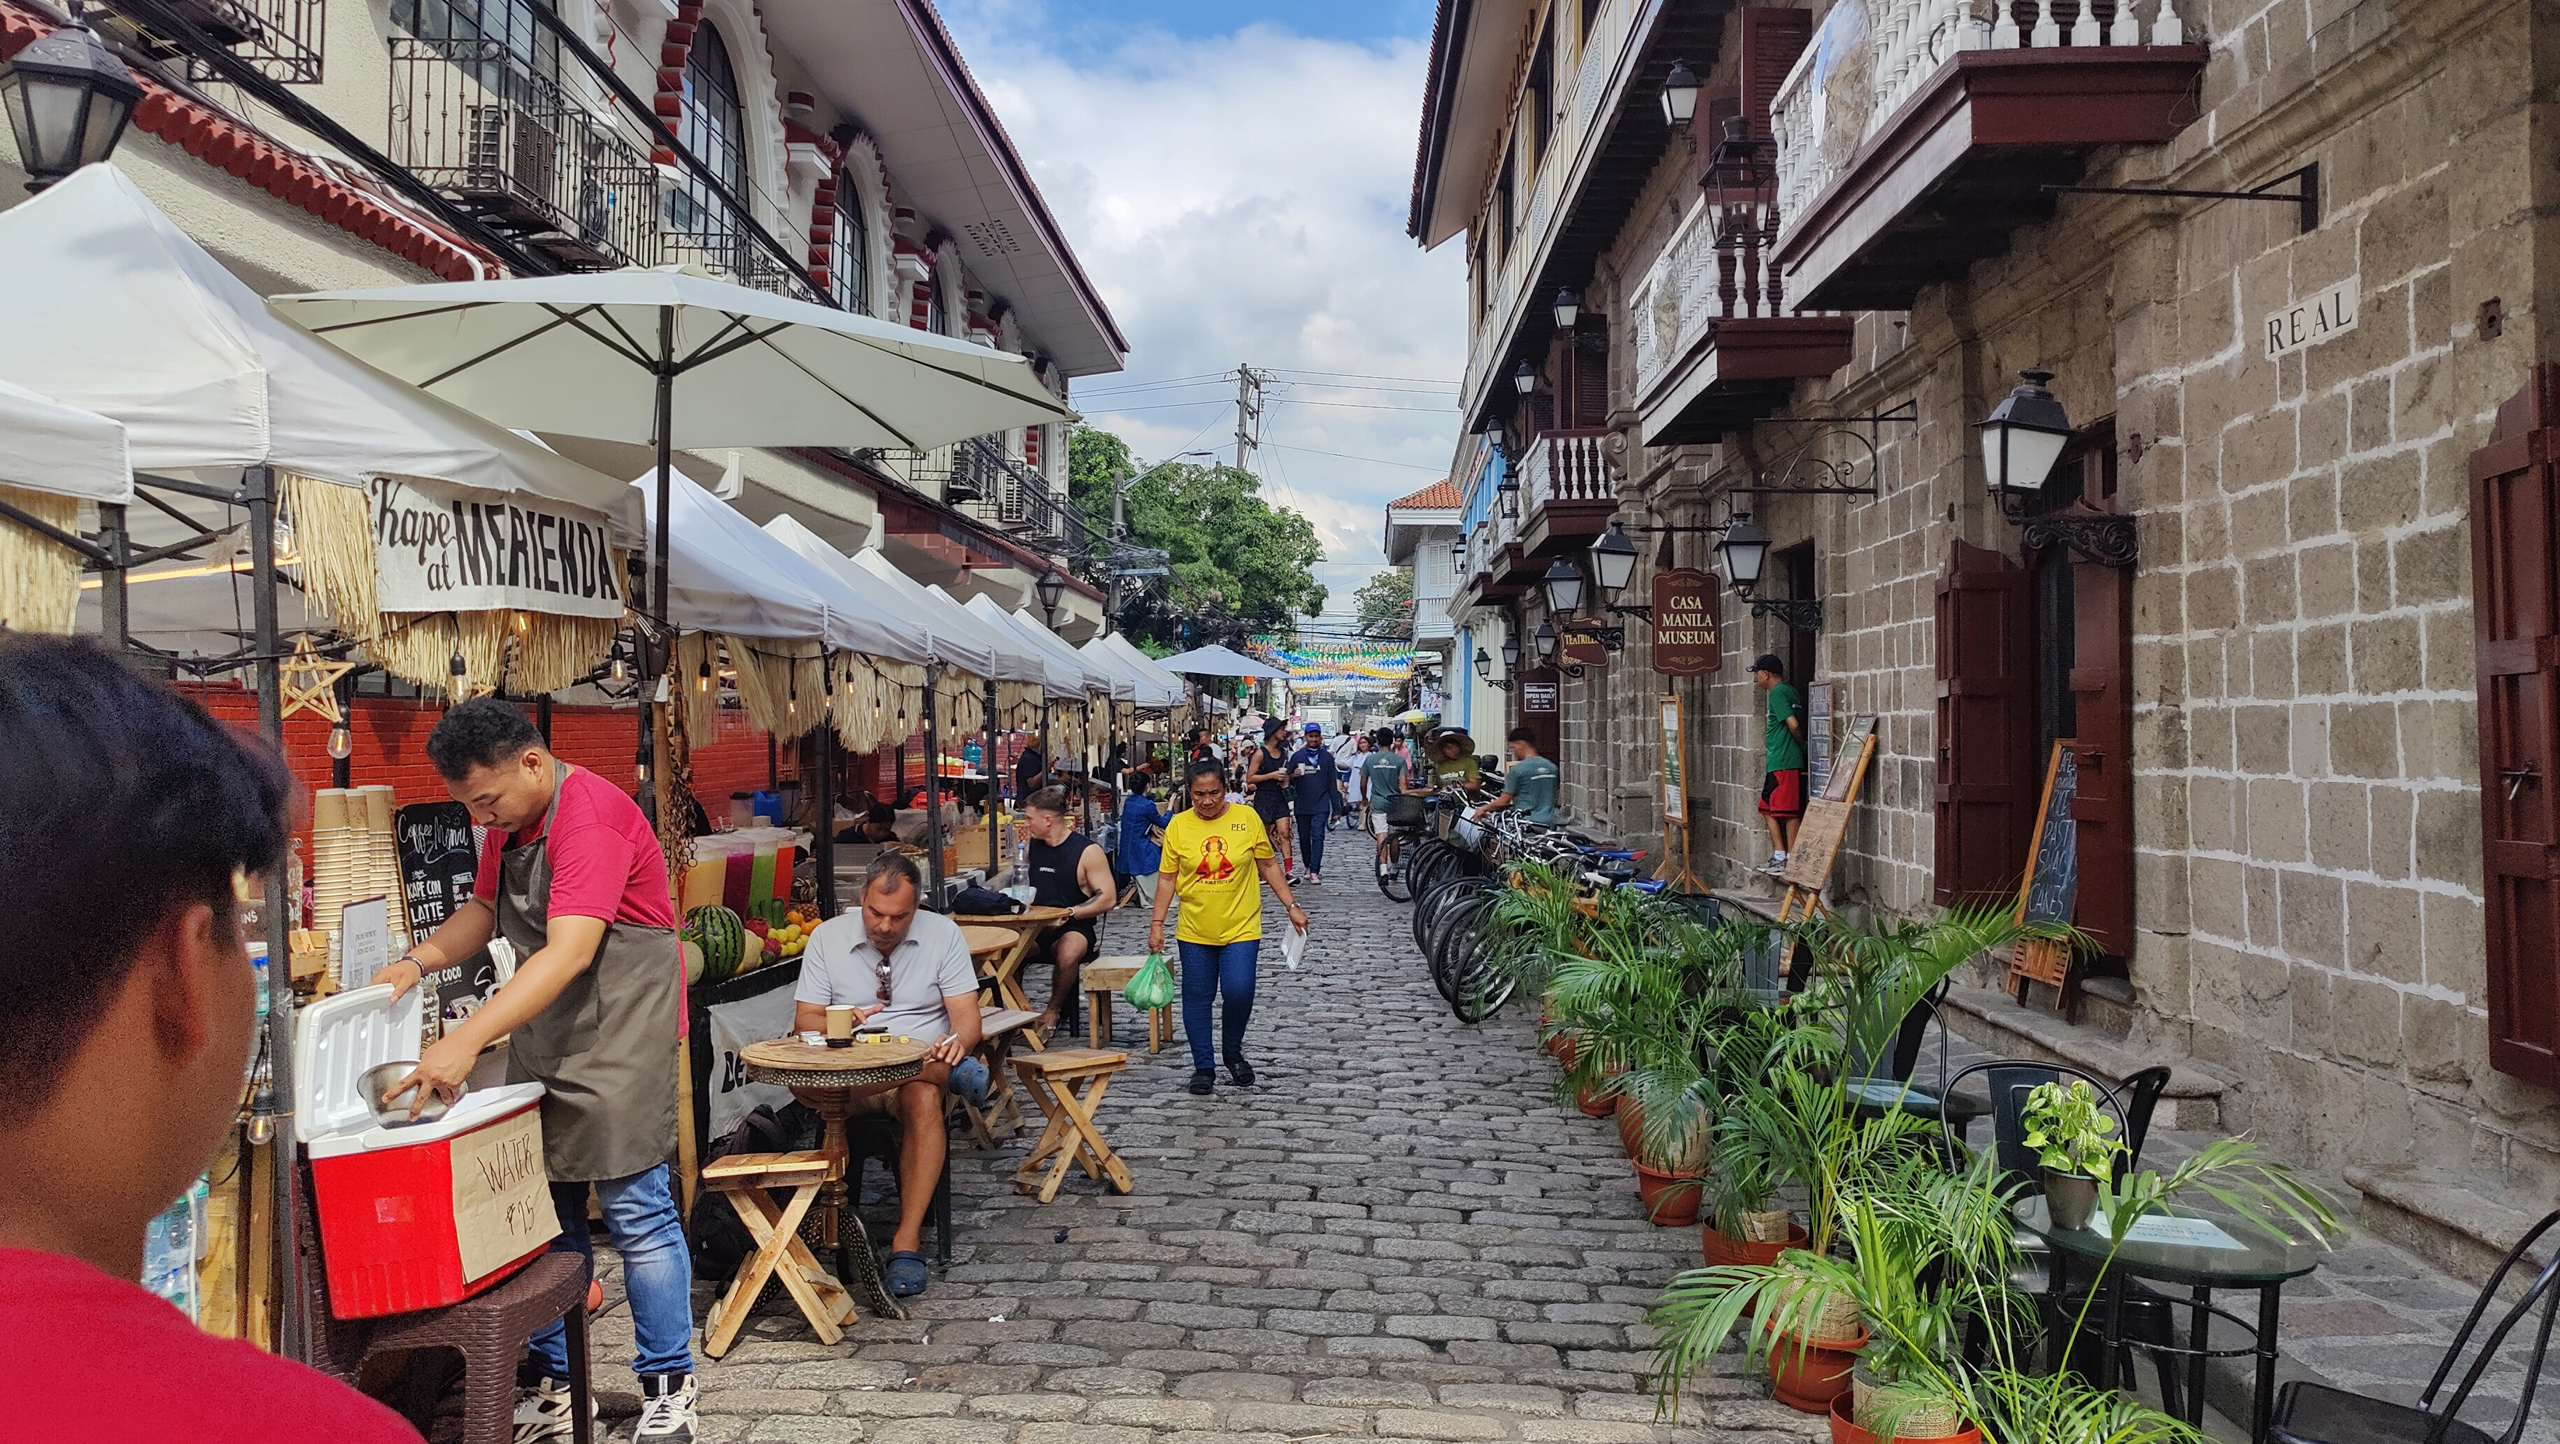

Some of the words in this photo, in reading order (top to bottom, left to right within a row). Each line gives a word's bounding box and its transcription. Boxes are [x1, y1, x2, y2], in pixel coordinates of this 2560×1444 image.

[2268, 291, 2353, 354] REAL
[371, 478, 456, 565] Kape
[427, 550, 455, 591] at
[453, 500, 619, 600] MERIENDA
[1670, 596, 1703, 609] CASA
[1662, 613, 1713, 627] MANILA
[1658, 631, 1716, 645] MUSEUM
[398, 814, 433, 854] Coffee
[434, 816, 469, 850] Menu
[406, 881, 426, 899] KAPE
[426, 880, 442, 895] CON
[410, 901, 444, 923] LATTE
[442, 965, 462, 982] COCO
[477, 1133, 534, 1194] WATER
